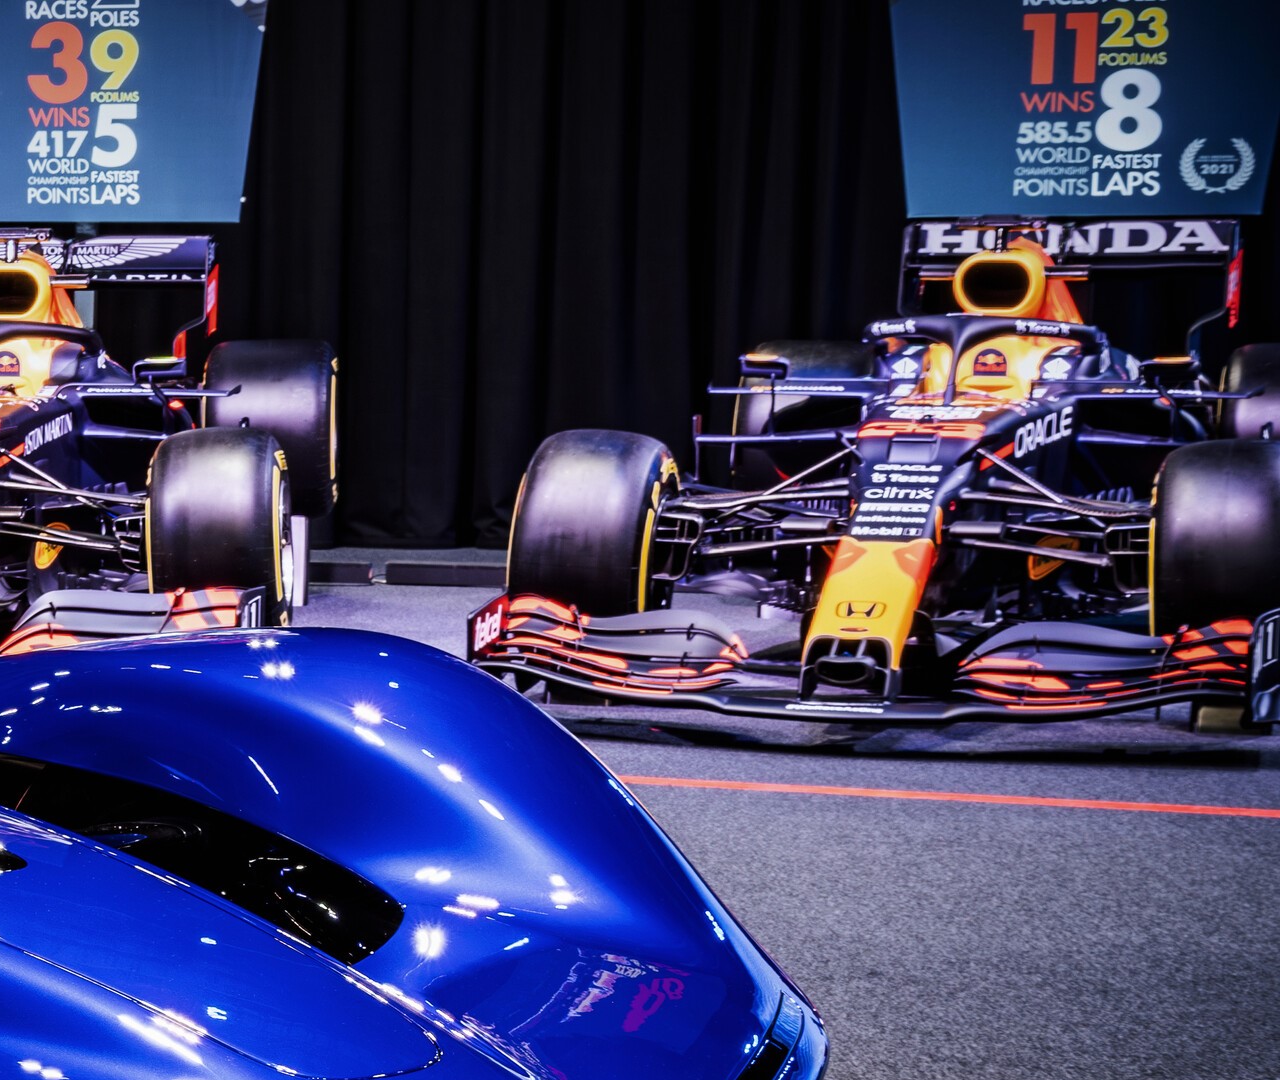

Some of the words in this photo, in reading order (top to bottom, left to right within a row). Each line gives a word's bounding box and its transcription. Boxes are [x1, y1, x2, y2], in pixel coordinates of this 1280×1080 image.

[25, 0, 88, 20] RACES
[90, 10, 140, 27] POLES
[1100, 7, 1169, 48] 23
[1023, 12, 1099, 85] 11
[27, 21, 88, 104] 3
[90, 29, 139, 91] 9
[1098, 52, 1167, 66] PODIUMS
[90, 91, 140, 103] PODIUMS
[1020, 90, 1096, 113] WINS
[28, 106, 90, 128] WINS
[1095, 68, 1163, 152] 8
[90, 103, 138, 168] 5
[1016, 121, 1092, 145] 585.5
[27, 130, 89, 158] 417
[1015, 147, 1090, 164] WORLD
[1092, 153, 1162, 170] FASTEST
[27, 158, 89, 174] WORLD
[1200, 164, 1235, 175] 2021
[28, 176, 89, 185] CHAMPIONSHIP
[90, 170, 139, 184] FASTEST
[1013, 177, 1089, 197] POINTS
[1091, 170, 1161, 197] LAPS
[27, 187, 90, 205] POINTS
[90, 184, 140, 205] LAPS
[918, 221, 1230, 254] HNDA
[77, 245, 119, 256] MARTIN
[23, 425, 44, 457] ASTON
[43, 411, 73, 444] MARTIN
[1014, 405, 1074, 459] ORACLE
[872, 463, 943, 472] ORACLE
[850, 526, 903, 536] Mobil
